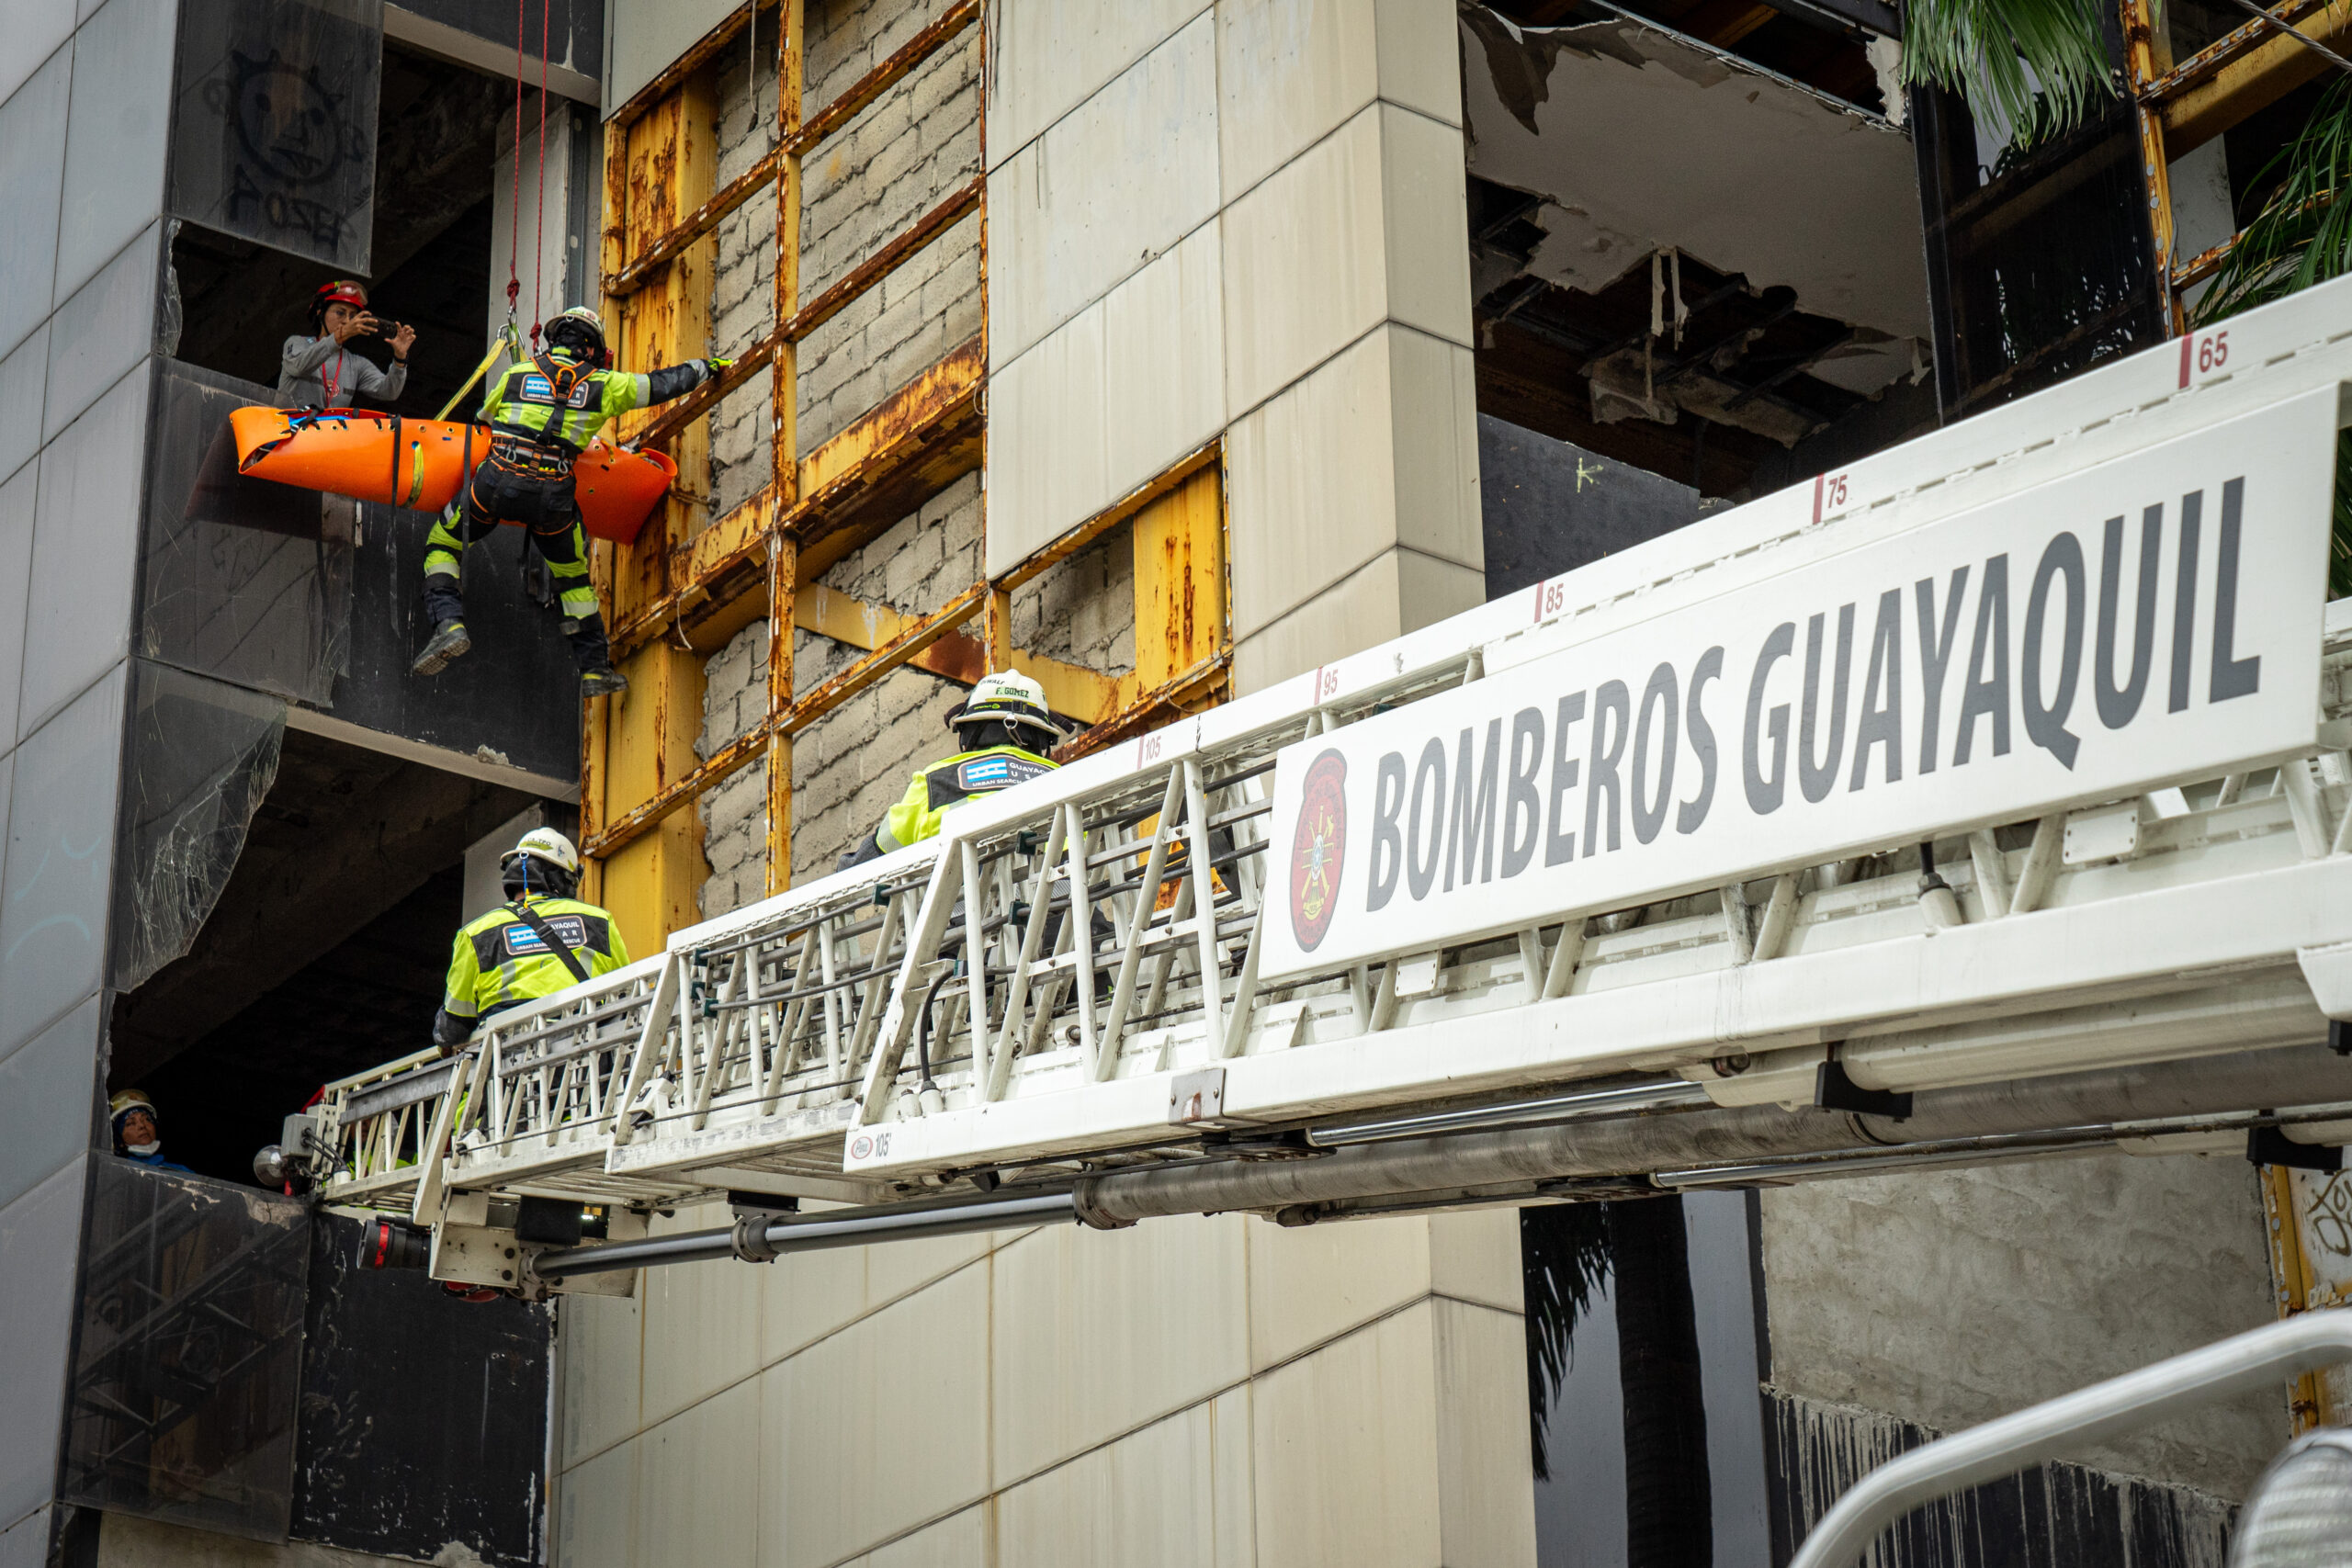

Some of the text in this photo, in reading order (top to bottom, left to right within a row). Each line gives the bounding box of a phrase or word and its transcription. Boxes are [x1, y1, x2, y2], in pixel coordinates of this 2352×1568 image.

[2199, 331, 2229, 373] 65
[1827, 473, 1849, 509] 75
[1545, 582, 1564, 615] 85
[995, 687, 1002, 695] F.
[1004, 686, 1030, 698] GOMEZ
[1323, 669, 1339, 696] 95
[1366, 475, 2262, 912] BOMBEROS GUAYAQUIL
[1146, 735, 1161, 761] 105
[972, 779, 995, 787] URBAN
